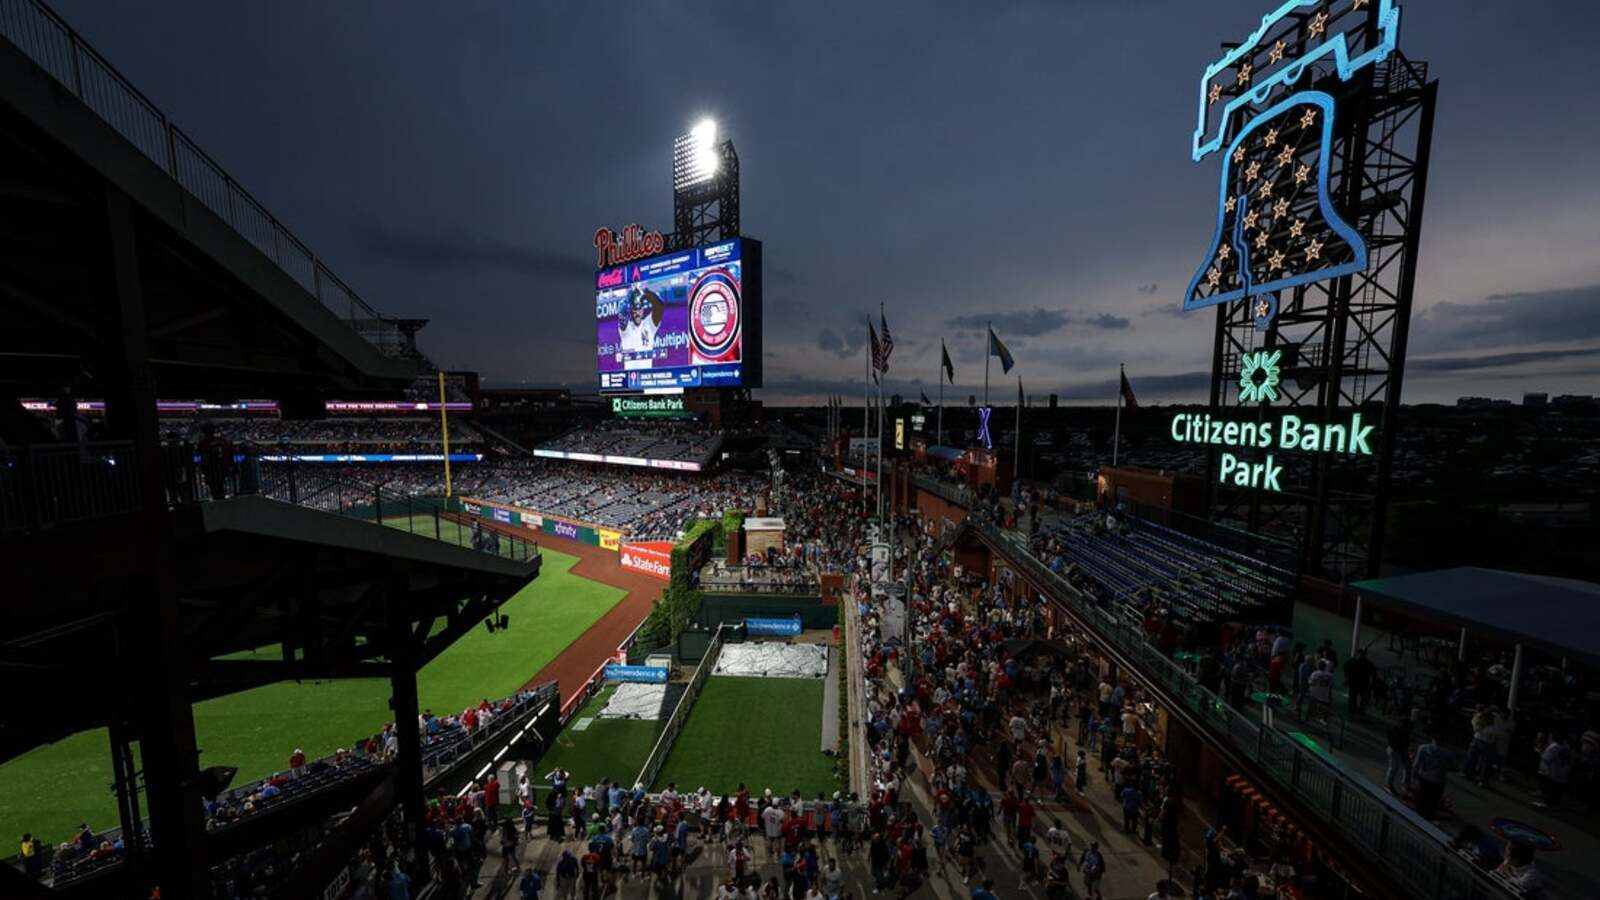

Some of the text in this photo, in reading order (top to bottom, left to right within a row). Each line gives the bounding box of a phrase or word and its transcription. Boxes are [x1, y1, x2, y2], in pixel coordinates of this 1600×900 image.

[594, 224, 663, 267] Phillies
[622, 398, 684, 410] Citizens Bank Park
[1171, 413, 1375, 455] Citizens Bank
[1220, 453, 1283, 492] Park
